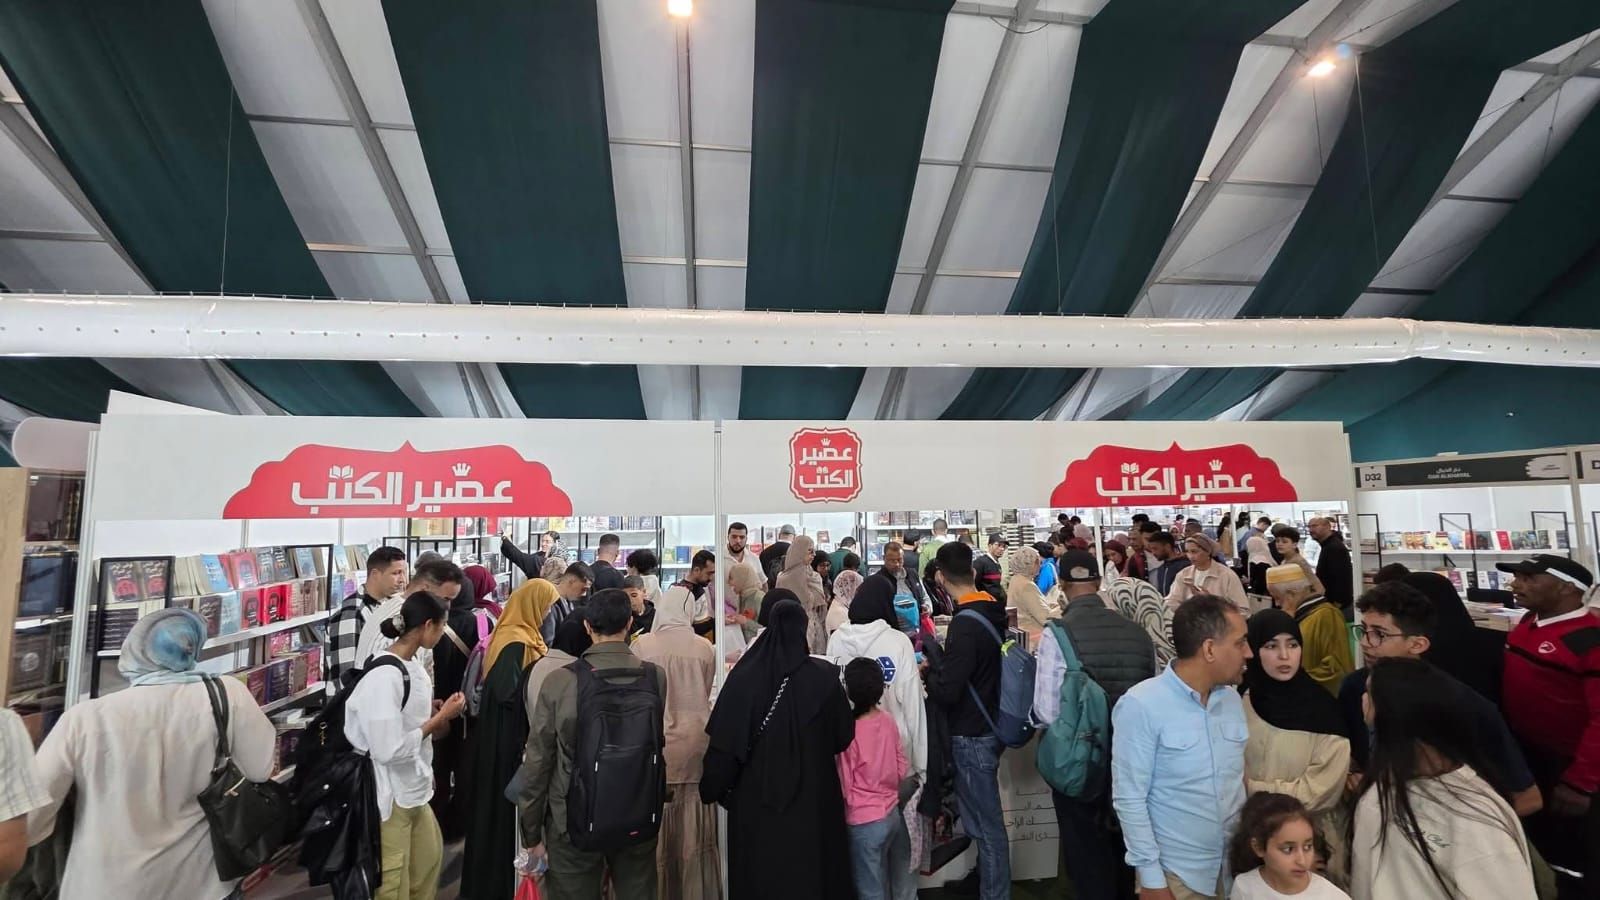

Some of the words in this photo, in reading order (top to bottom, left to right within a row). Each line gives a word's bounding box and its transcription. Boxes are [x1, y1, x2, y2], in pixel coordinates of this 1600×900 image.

[799, 446, 853, 466] عصير
[291, 464, 404, 515] الكتب
[799, 466, 853, 493] الكتب
[1096, 462, 1177, 504] الكتب
[1180, 471, 1256, 502] عصير
[1365, 472, 1382, 482] D32
[406, 478, 513, 513] عصير
